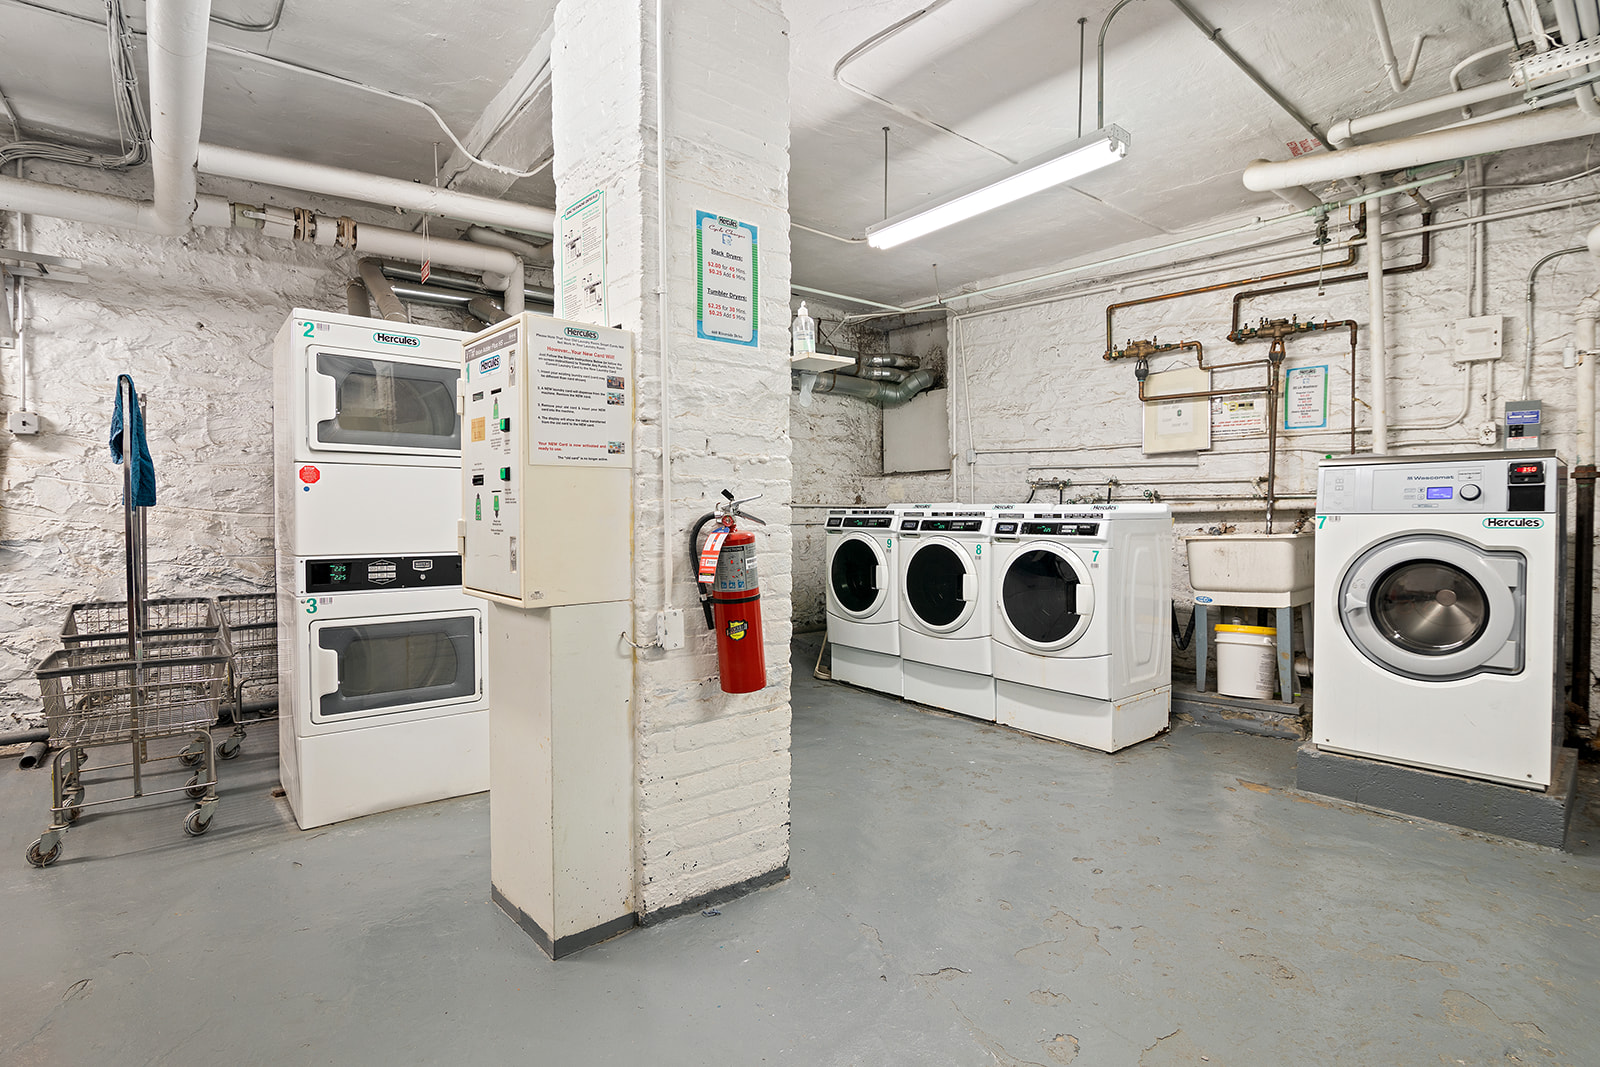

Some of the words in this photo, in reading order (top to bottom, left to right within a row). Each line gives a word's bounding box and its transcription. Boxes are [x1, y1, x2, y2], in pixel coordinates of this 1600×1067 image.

[726, 252, 743, 262] Dryers:
[708, 288, 728, 297] Tumbler
[730, 293, 747, 301] Dryers:
[303, 322, 314, 338] 2
[567, 328, 596, 338] Hercules
[377, 333, 417, 346] Hercules
[481, 358, 500, 371] Hercules
[1317, 516, 1327, 529] 7
[1488, 518, 1539, 527] Hercules
[887, 539, 892, 548] 9
[976, 544, 982, 554] 8
[1092, 551, 1100, 562] 7
[306, 598, 317, 614] 3
